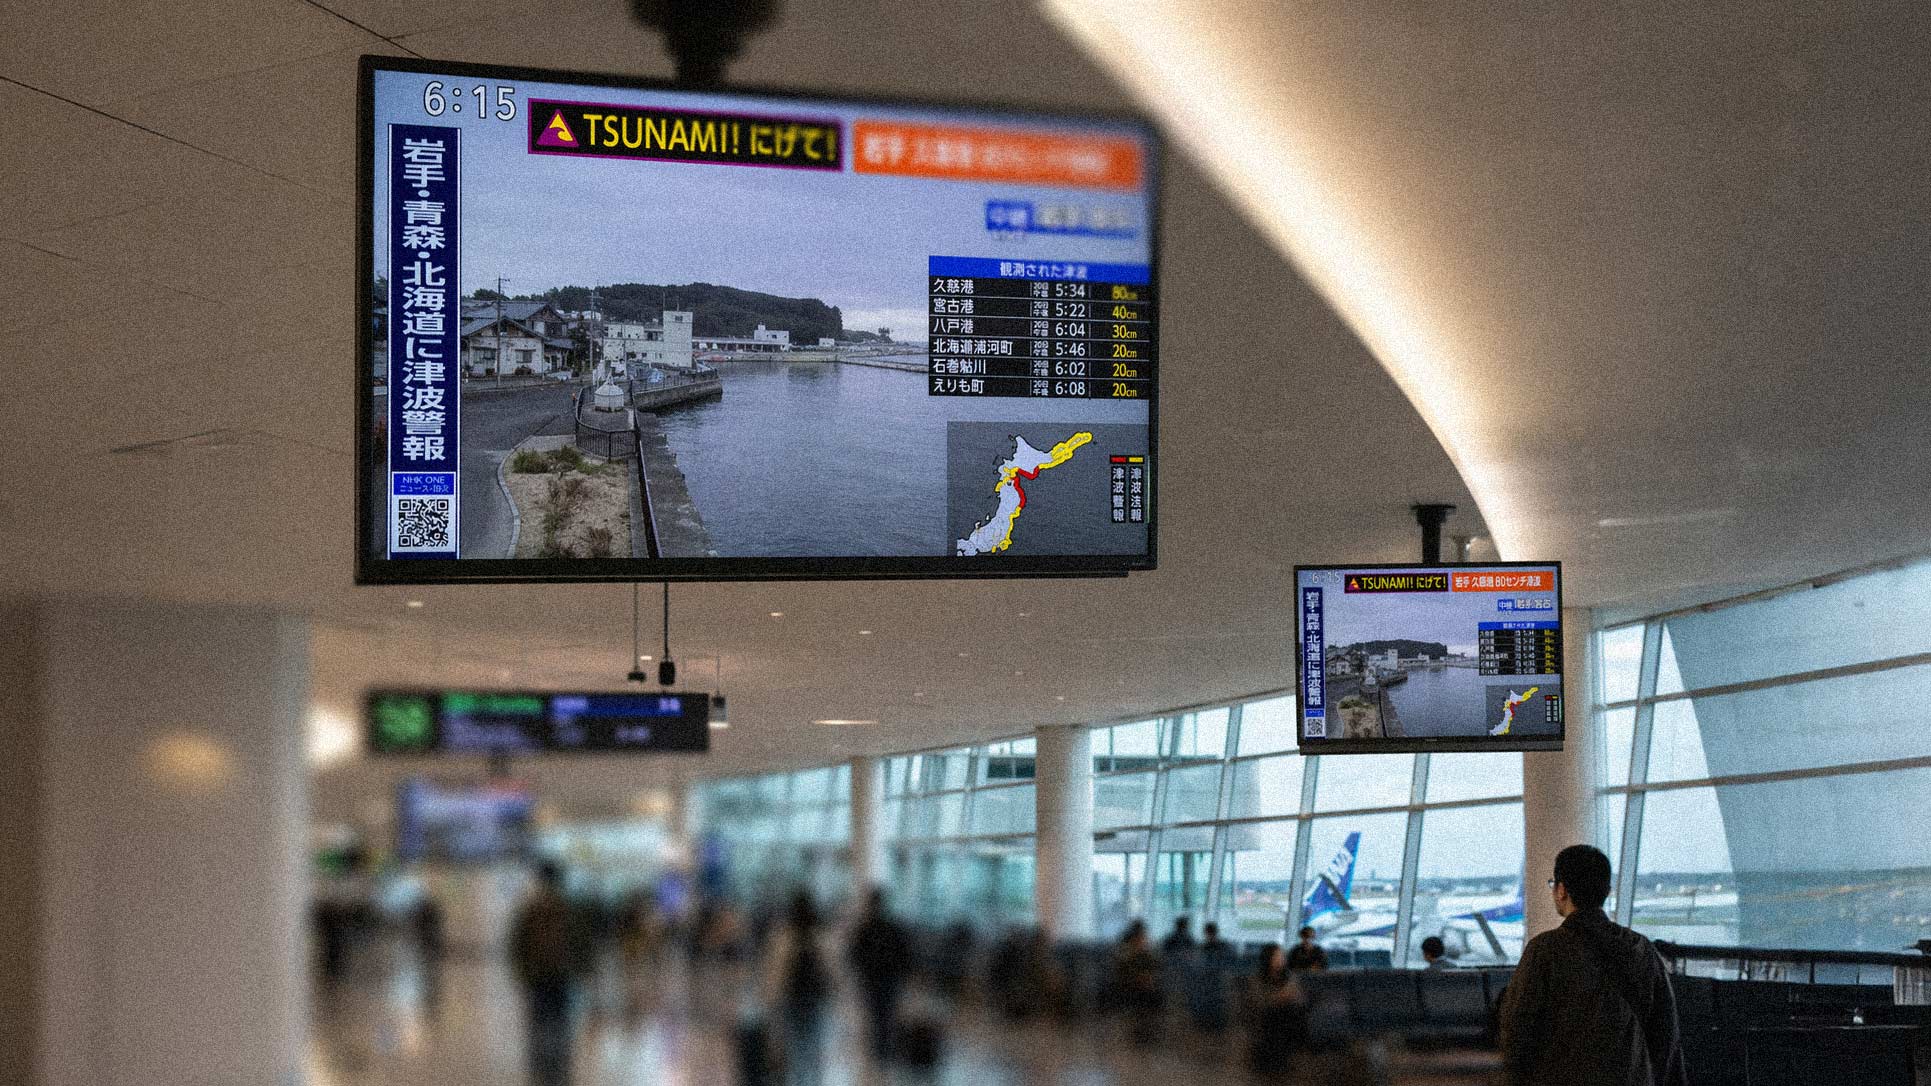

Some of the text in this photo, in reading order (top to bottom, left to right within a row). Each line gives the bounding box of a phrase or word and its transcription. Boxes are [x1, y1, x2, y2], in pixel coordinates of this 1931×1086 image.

[424, 81, 517, 121] 6:15
[583, 113, 739, 154] TSUNAMI!
[403, 138, 446, 461] 岩手・青森・北海道に津波警報
[1056, 284, 1085, 297] 5:34
[933, 298, 1136, 319] 宮古港 5:22 40cm
[933, 318, 1137, 338] 八戸港 6:04 30cm
[1056, 342, 1085, 356] 5:46
[1113, 344, 1136, 357] 20cm
[1056, 362, 1085, 375] 6:02
[1113, 363, 1136, 377] 20cm
[933, 378, 1137, 396] えりも町 6:08 20cm
[403, 476, 445, 484] NHK ONE
[1361, 576, 1446, 590] TSUNAMI! にげて!
